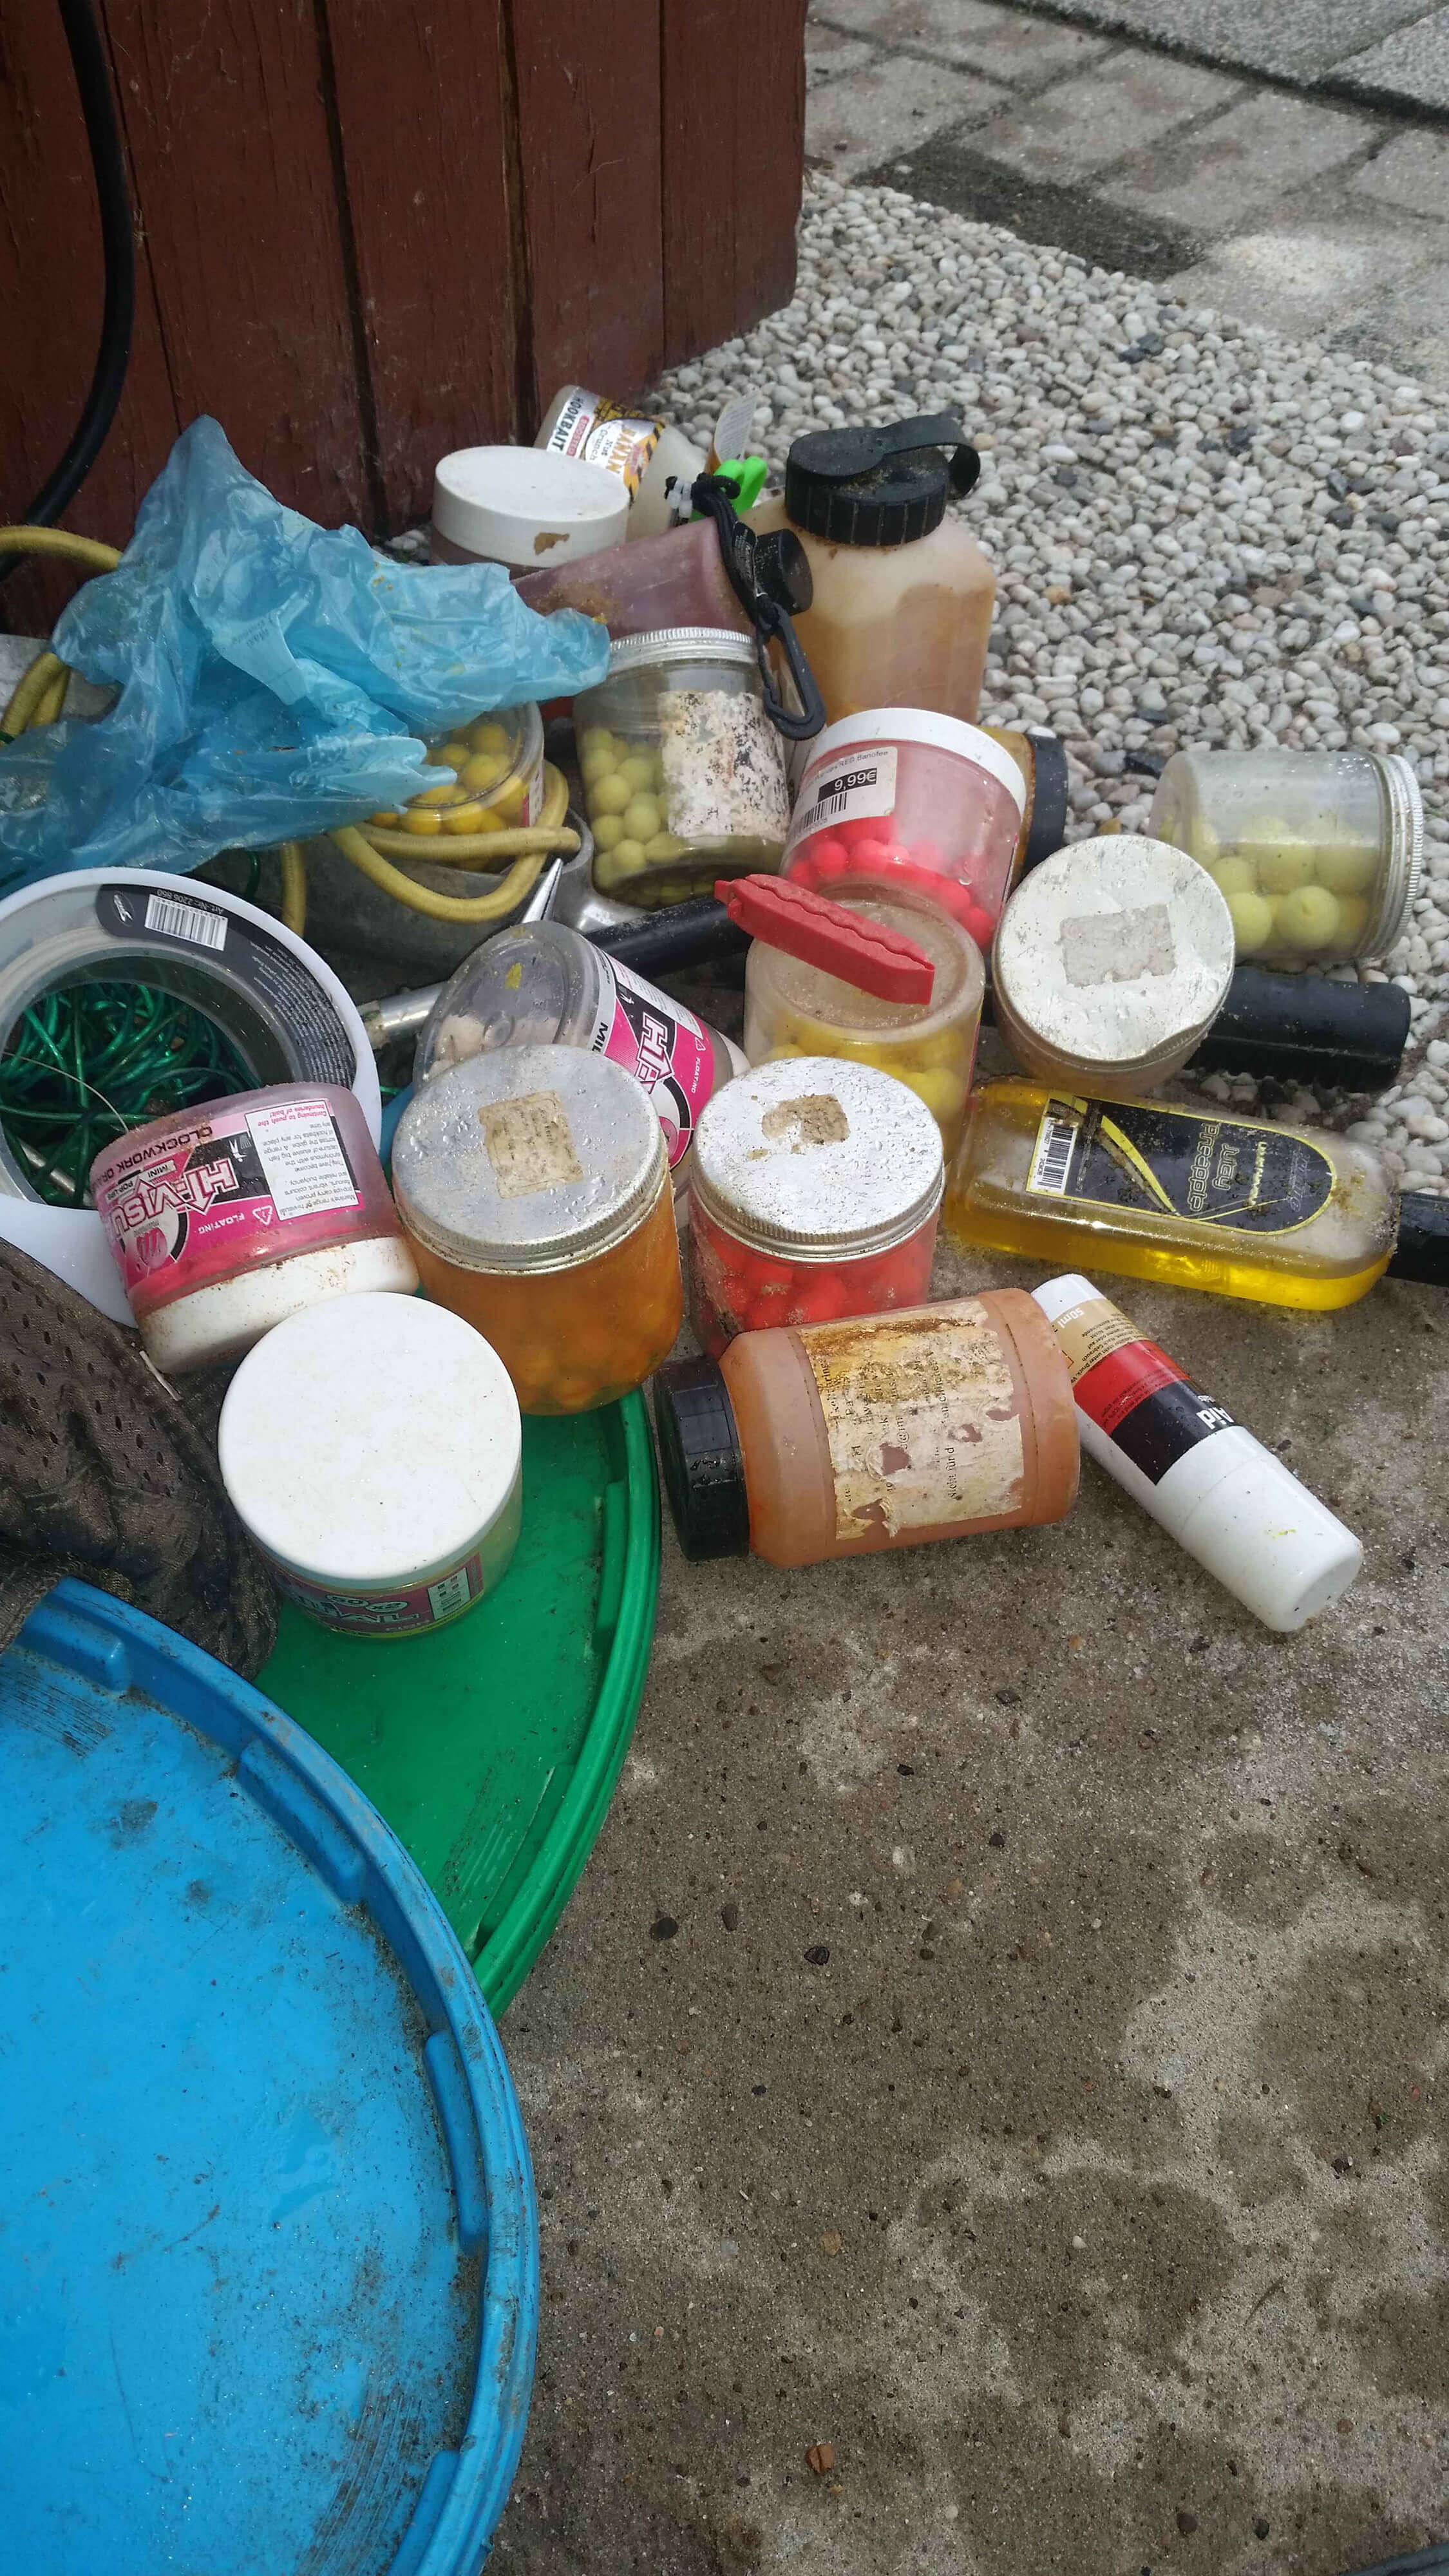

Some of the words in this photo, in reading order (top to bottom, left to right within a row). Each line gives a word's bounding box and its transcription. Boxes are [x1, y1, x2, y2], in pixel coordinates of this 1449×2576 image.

[552, 397, 585, 451] HOOKBAIT
[606, 426, 636, 474] BANAN
[857, 751, 889, 761] Banofee
[835, 770, 876, 791] 9,99€
[117, 1126, 213, 1173] CLOCKWORK
[147, 1164, 168, 1177] MINI
[110, 1158, 240, 1235] HI-VISU
[198, 1213, 245, 1234] FLOATING
[1057, 1307, 1085, 1328] 50ml
[1082, 1344, 1103, 1361] Gebrauch
[1090, 1352, 1102, 1363] unter
[1196, 1406, 1235, 1430] Aid
